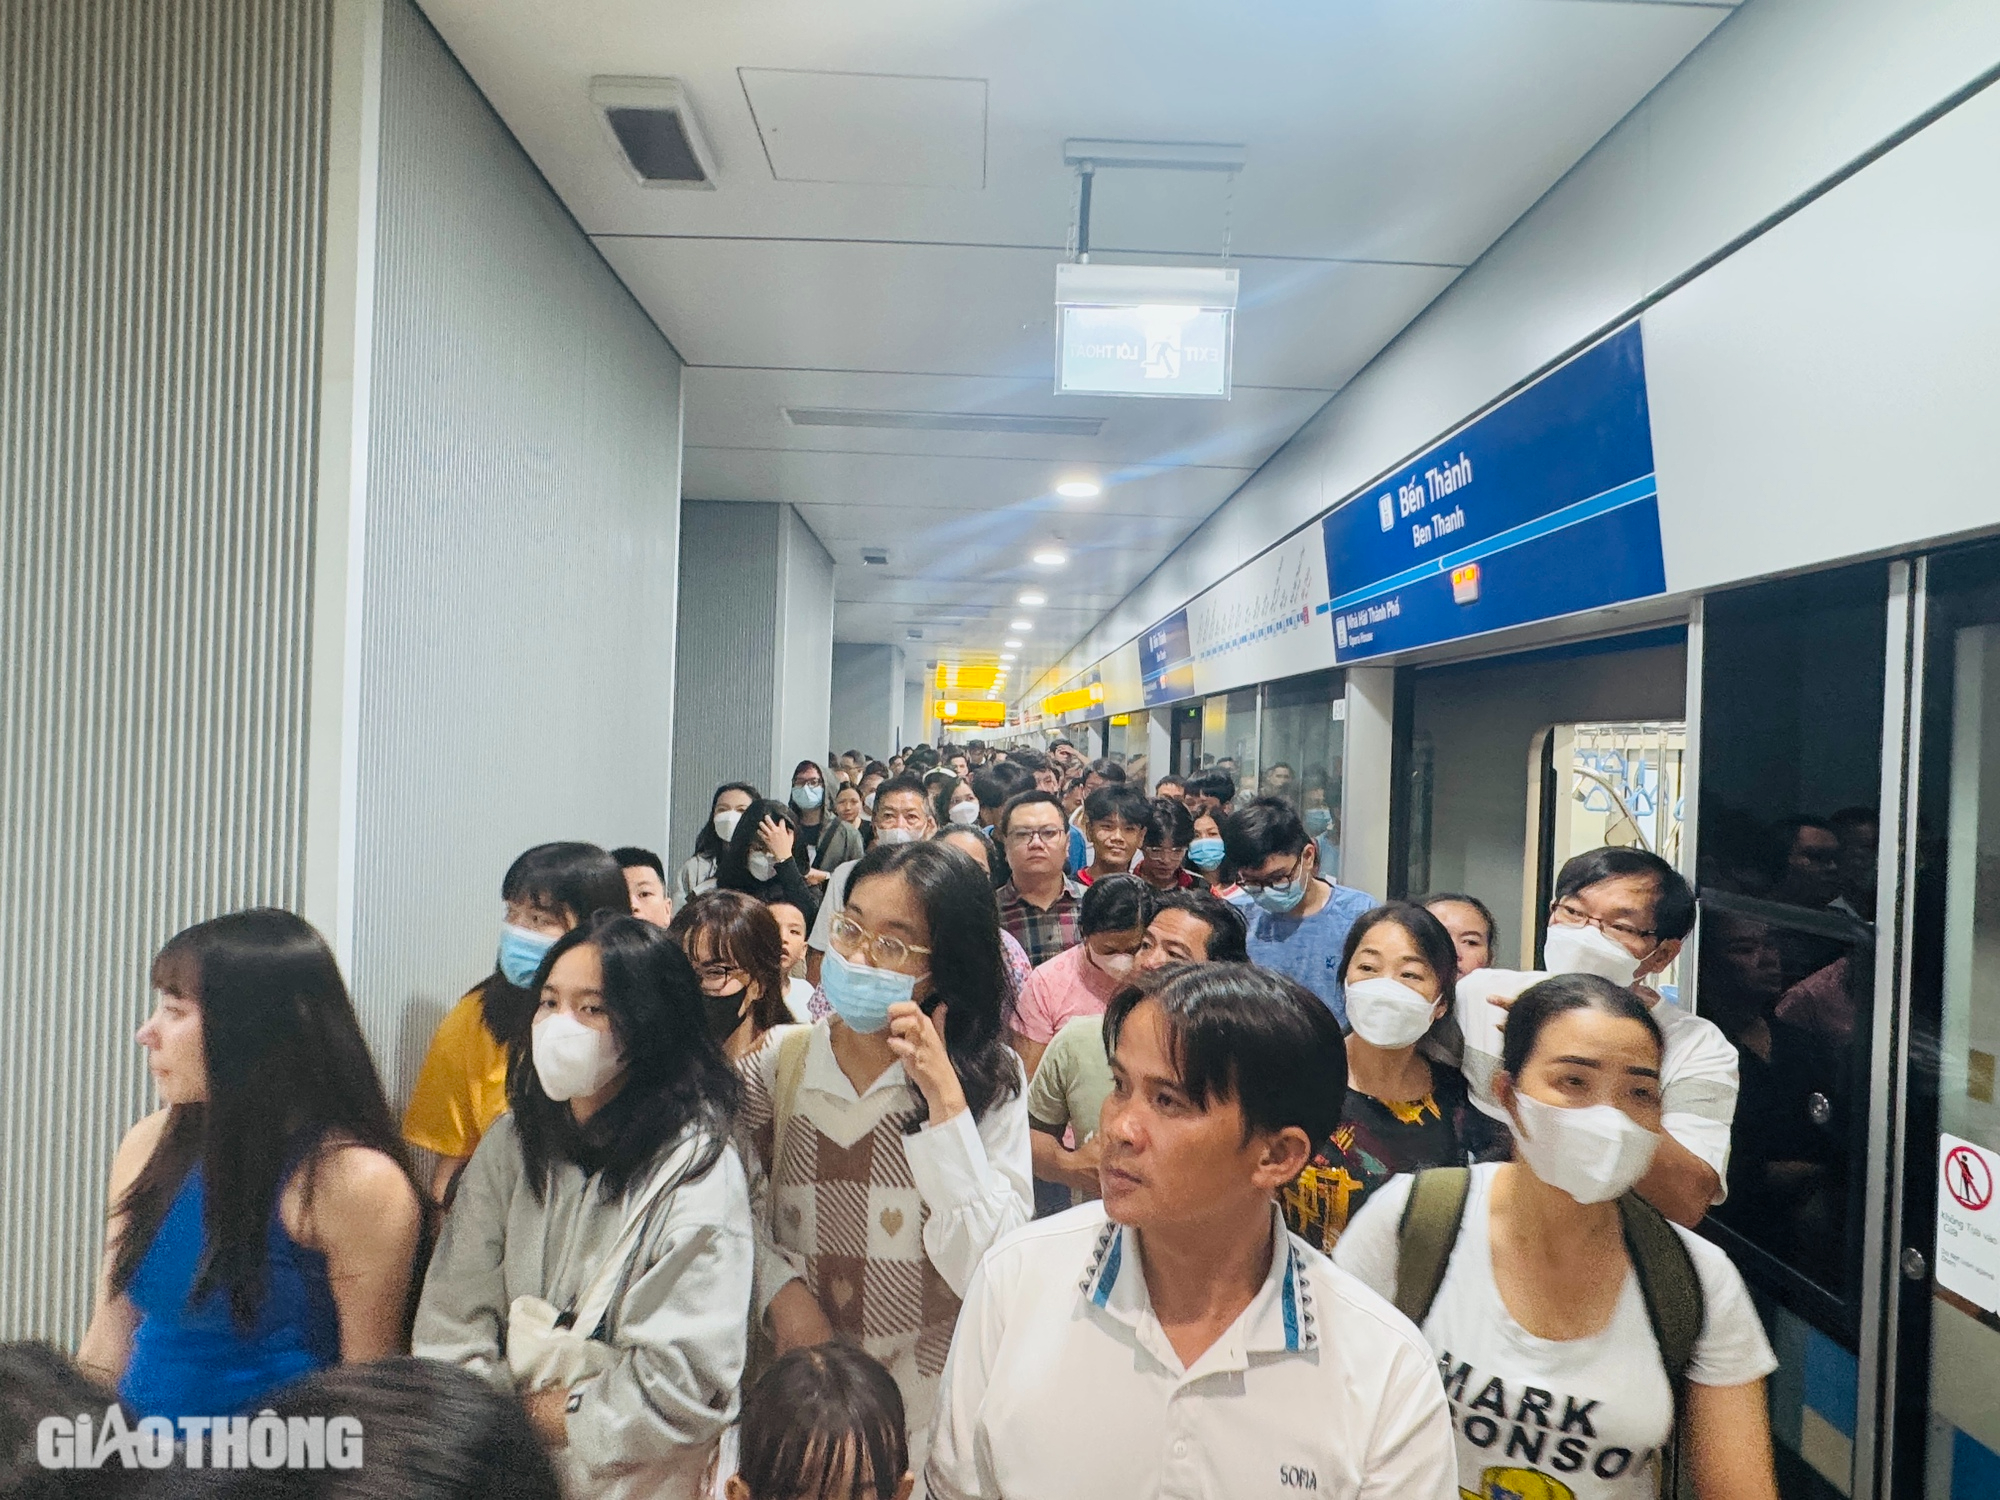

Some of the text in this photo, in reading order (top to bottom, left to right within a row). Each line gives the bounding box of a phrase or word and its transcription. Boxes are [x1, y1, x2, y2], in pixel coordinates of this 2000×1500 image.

[1398, 474, 1425, 519] Bến
[1424, 451, 1473, 503] Thành
[1412, 504, 1465, 548] Ben Thanh
[1438, 1350, 1605, 1437] MARK
